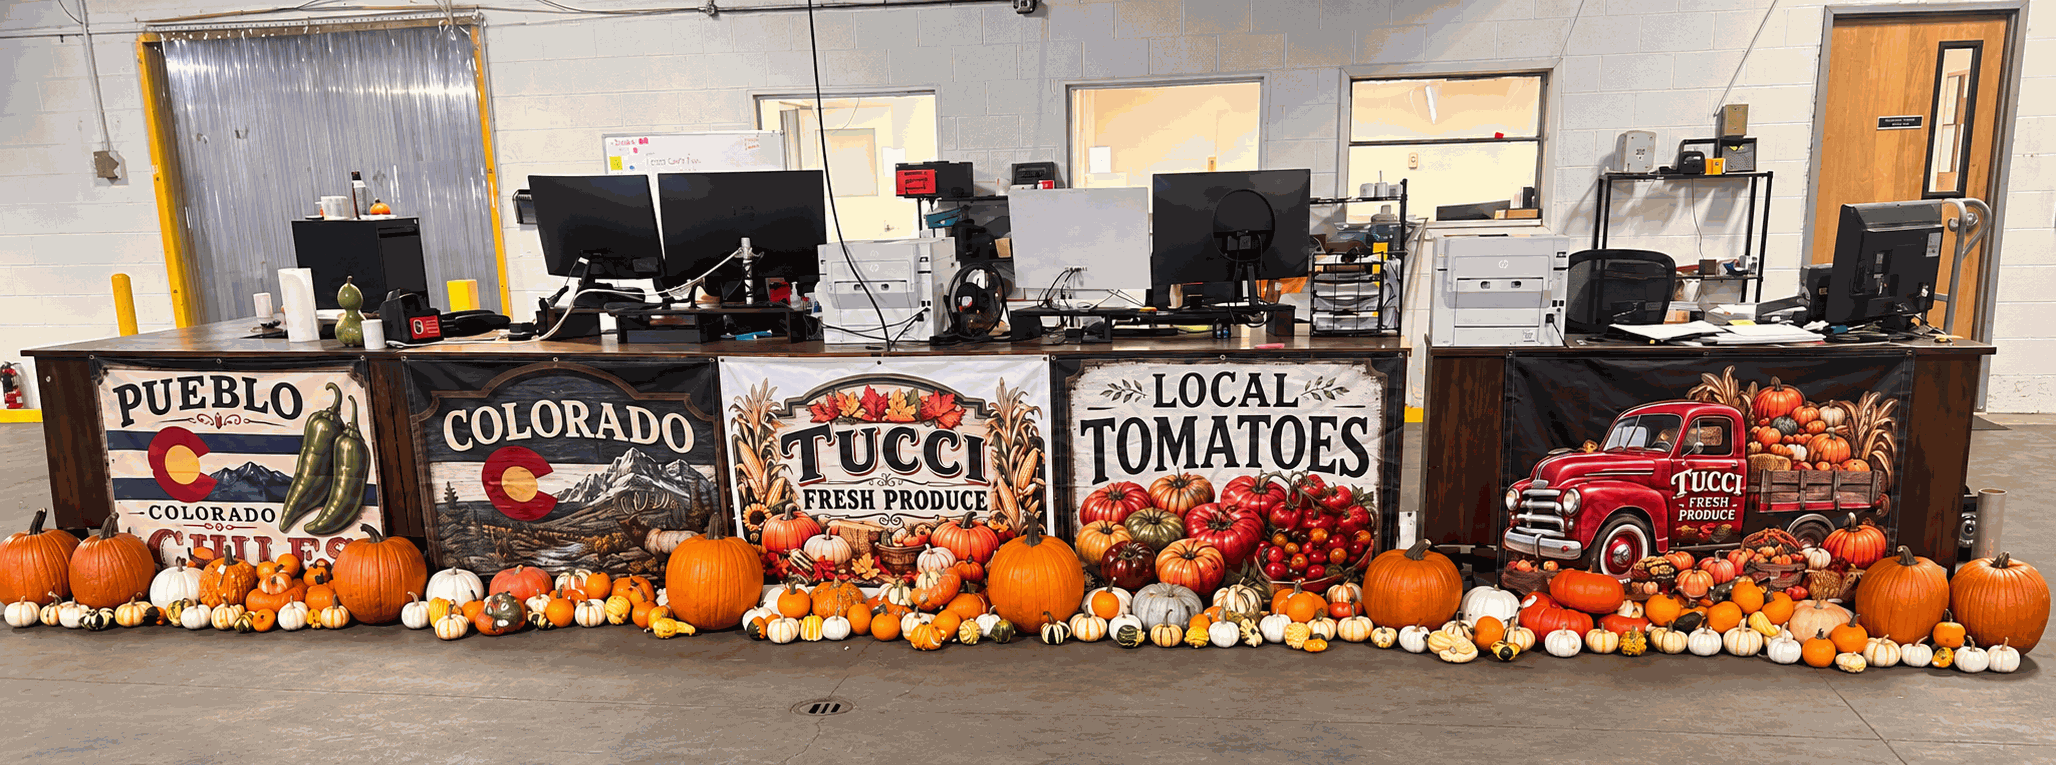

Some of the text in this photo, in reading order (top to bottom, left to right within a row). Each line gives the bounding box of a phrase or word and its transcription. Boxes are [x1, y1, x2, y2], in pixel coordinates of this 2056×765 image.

[112, 375, 303, 428] PUEBLO
[1152, 371, 1299, 408] LOCAL
[443, 399, 695, 453] COLORADO
[779, 423, 991, 486] TUCCI
[1080, 415, 1369, 486] TOMATOES
[1670, 468, 1743, 496] TUCCI
[149, 505, 276, 523] COLORADO
[803, 488, 988, 511] FRESH PRODUCE
[1678, 509, 1735, 522] PRODUCE
[1689, 496, 1729, 508] FRESH
